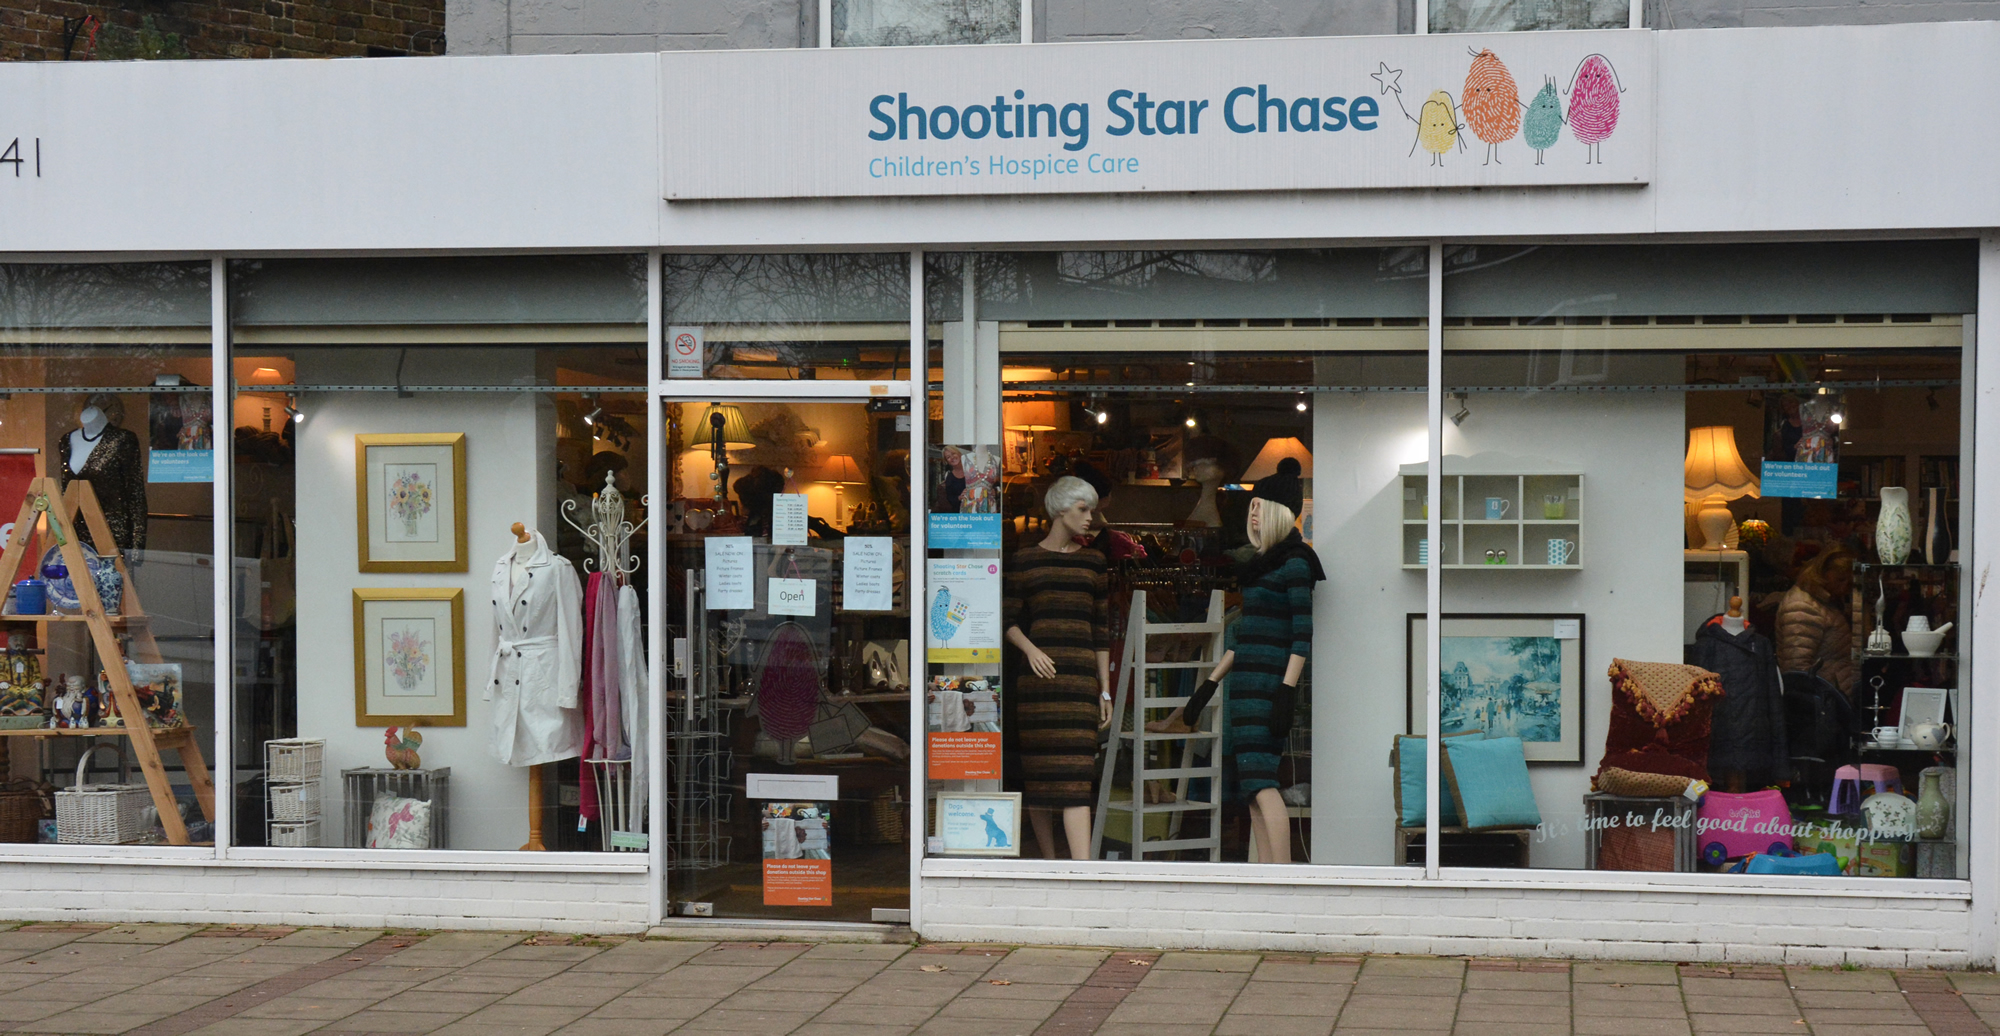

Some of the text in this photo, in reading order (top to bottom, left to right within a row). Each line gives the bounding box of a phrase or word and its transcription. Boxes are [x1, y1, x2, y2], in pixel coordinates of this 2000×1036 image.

[868, 84, 1379, 152] Shooting Star Chase
[868, 153, 1140, 180] Children's Hospice Care
[780, 591, 804, 602] Open
[1536, 819, 1568, 844] It's
[1576, 814, 1621, 832] time
[1626, 810, 1646, 828] to
[1651, 808, 1692, 833] feel
[1696, 815, 1748, 835] good
[1754, 816, 1814, 838] about
